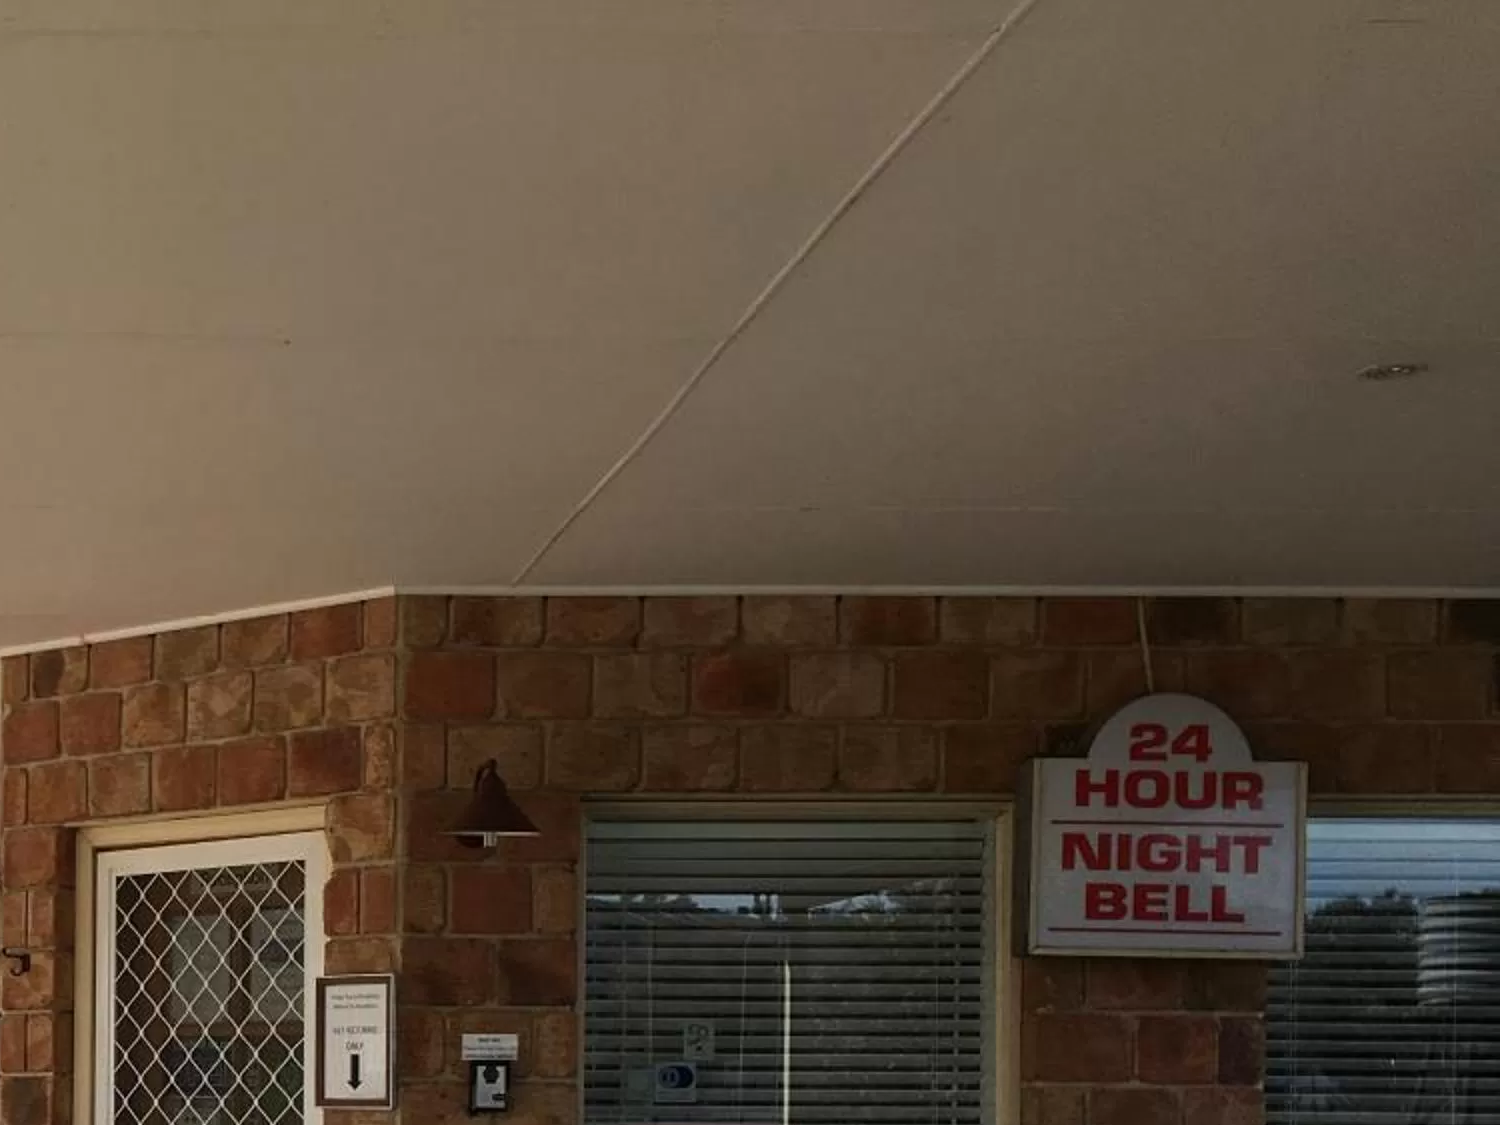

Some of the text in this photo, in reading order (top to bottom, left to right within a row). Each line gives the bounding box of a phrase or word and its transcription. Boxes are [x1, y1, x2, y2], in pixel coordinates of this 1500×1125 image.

[1128, 722, 1213, 763] 24
[1075, 768, 1265, 810] HOUR
[1061, 832, 1273, 874] NIGHT
[1084, 881, 1245, 923] BELL
